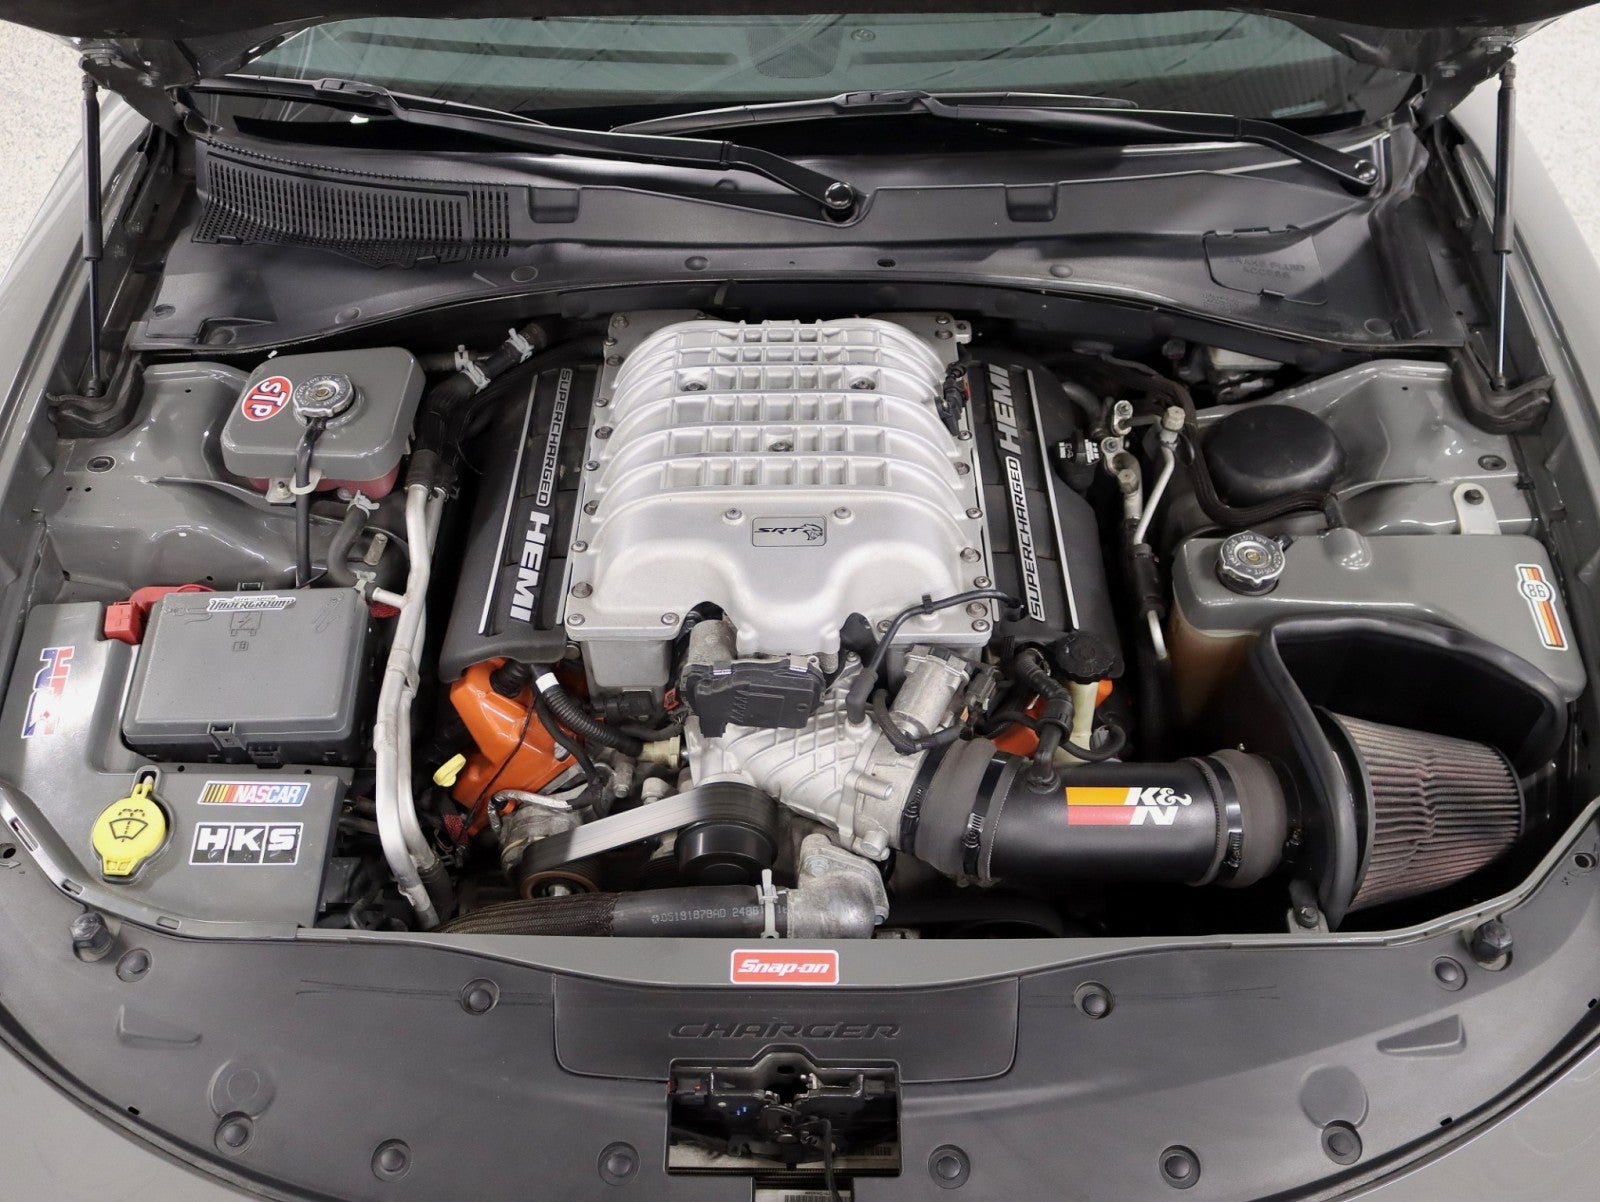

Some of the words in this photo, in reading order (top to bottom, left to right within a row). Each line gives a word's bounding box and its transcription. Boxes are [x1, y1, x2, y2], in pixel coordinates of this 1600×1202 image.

[249, 380, 287, 418] STP
[988, 364, 1021, 455] HEMI
[538, 369, 572, 506] SUPERCHARGED
[754, 527, 804, 535] SRT
[1006, 457, 1044, 620] SUPERCHARGED
[510, 511, 550, 622] HEMI
[1527, 584, 1547, 598] 86
[233, 783, 302, 804] NASCAR
[197, 827, 297, 851] HKS
[738, 959, 830, 976] Snap-on
[669, 1022, 901, 1039] CHARGER
